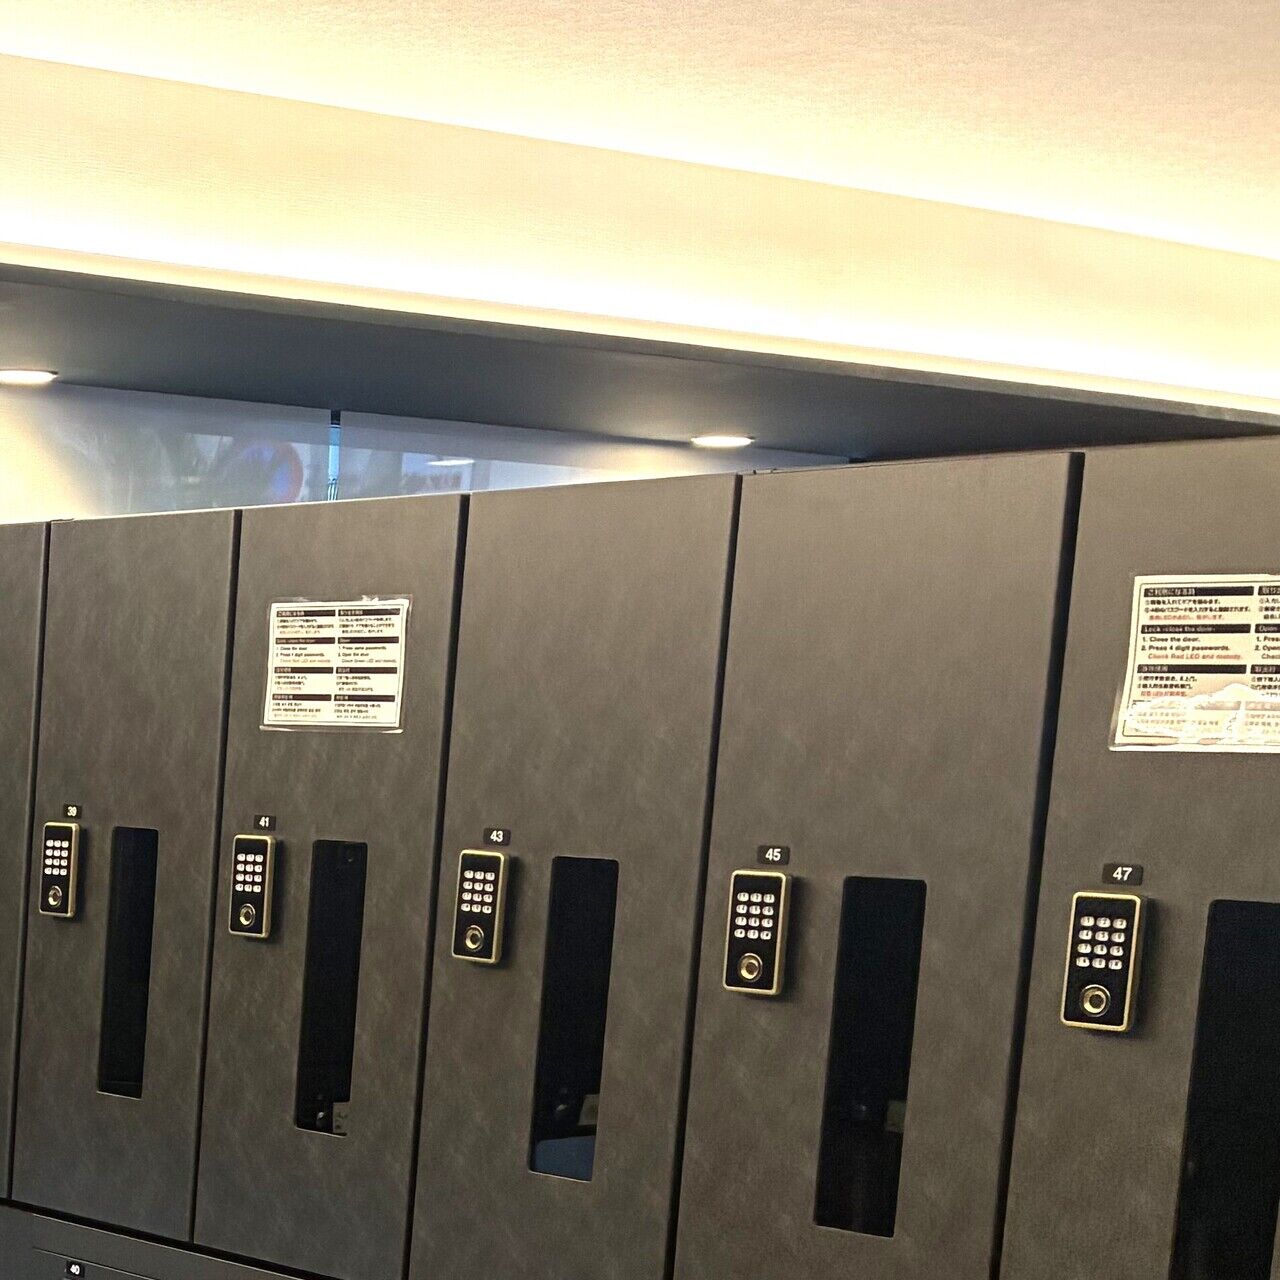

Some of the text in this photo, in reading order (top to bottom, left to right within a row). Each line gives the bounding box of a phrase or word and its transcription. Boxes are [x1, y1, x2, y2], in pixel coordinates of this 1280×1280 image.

[259, 816, 270, 827] 41
[490, 830, 504, 843] 43
[765, 848, 782, 862] 45
[1112, 866, 1133, 881] 47
[69, 1264, 80, 1275] 40
